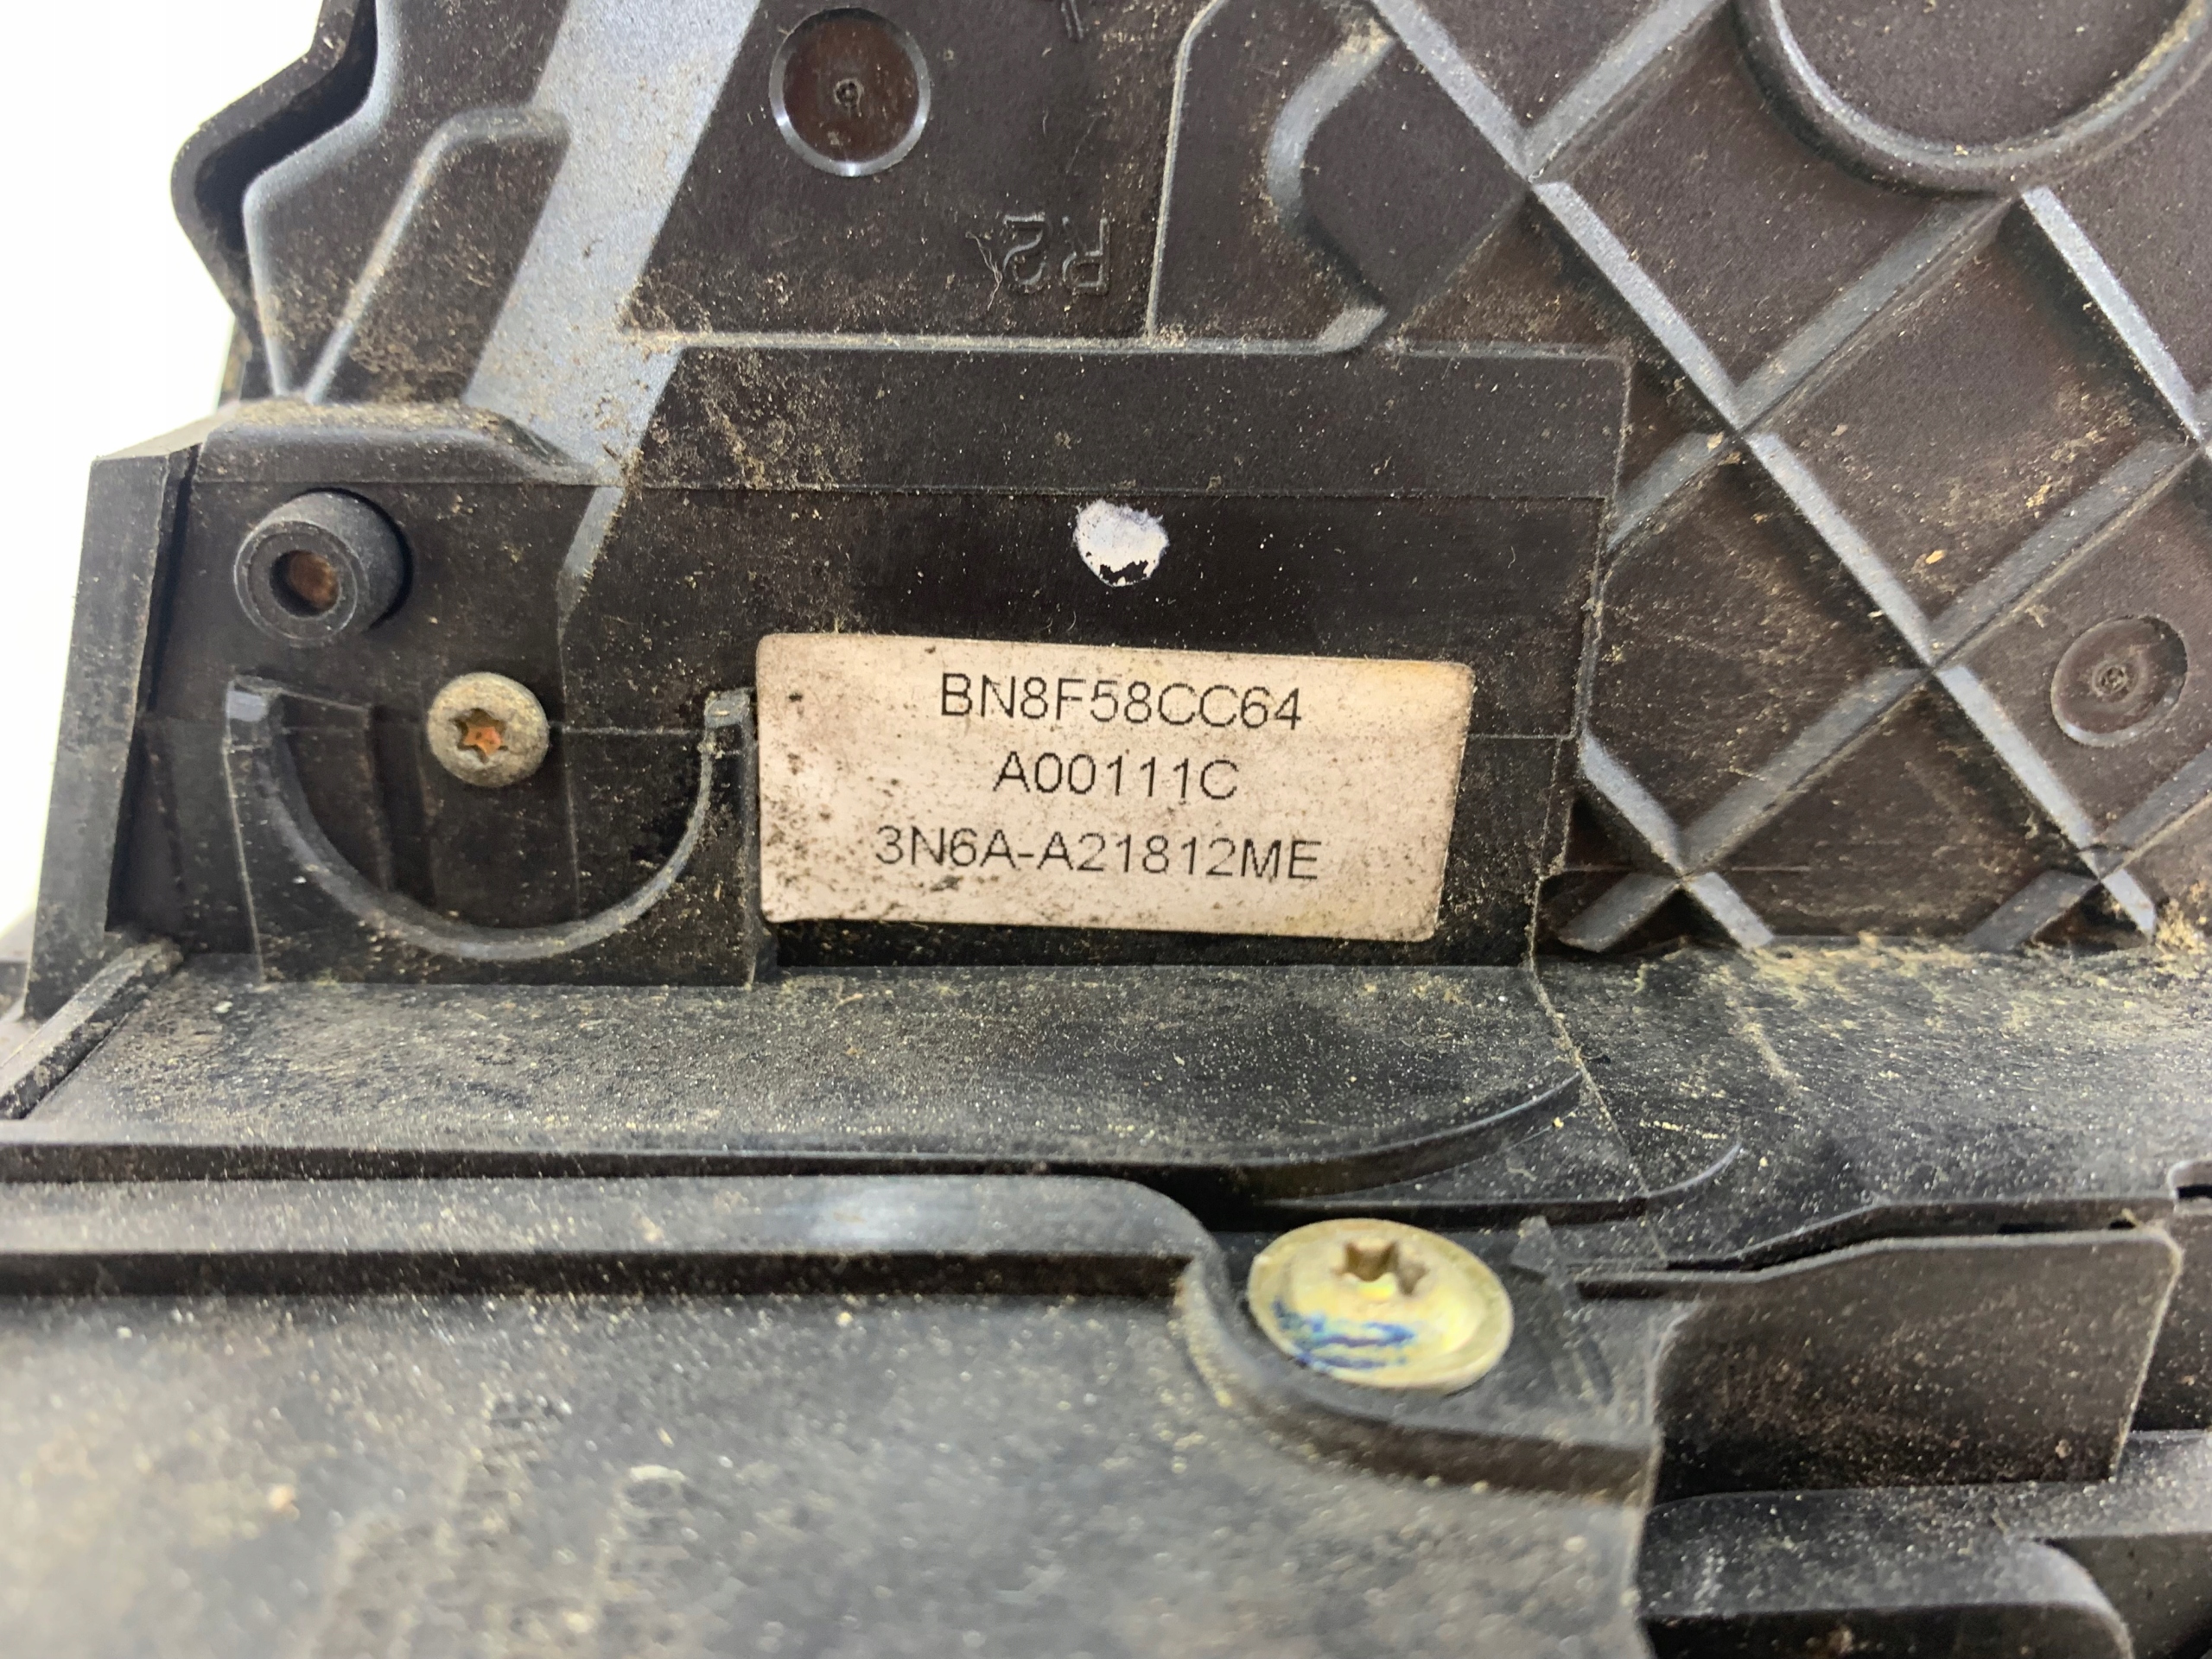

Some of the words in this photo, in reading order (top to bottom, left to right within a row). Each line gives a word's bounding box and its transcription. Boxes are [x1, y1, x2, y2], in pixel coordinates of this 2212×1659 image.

[941, 671, 1303, 731] BN8F58CC64
[991, 750, 1239, 800] A00111C
[874, 825, 1321, 881] 3N6A-A21812ME
